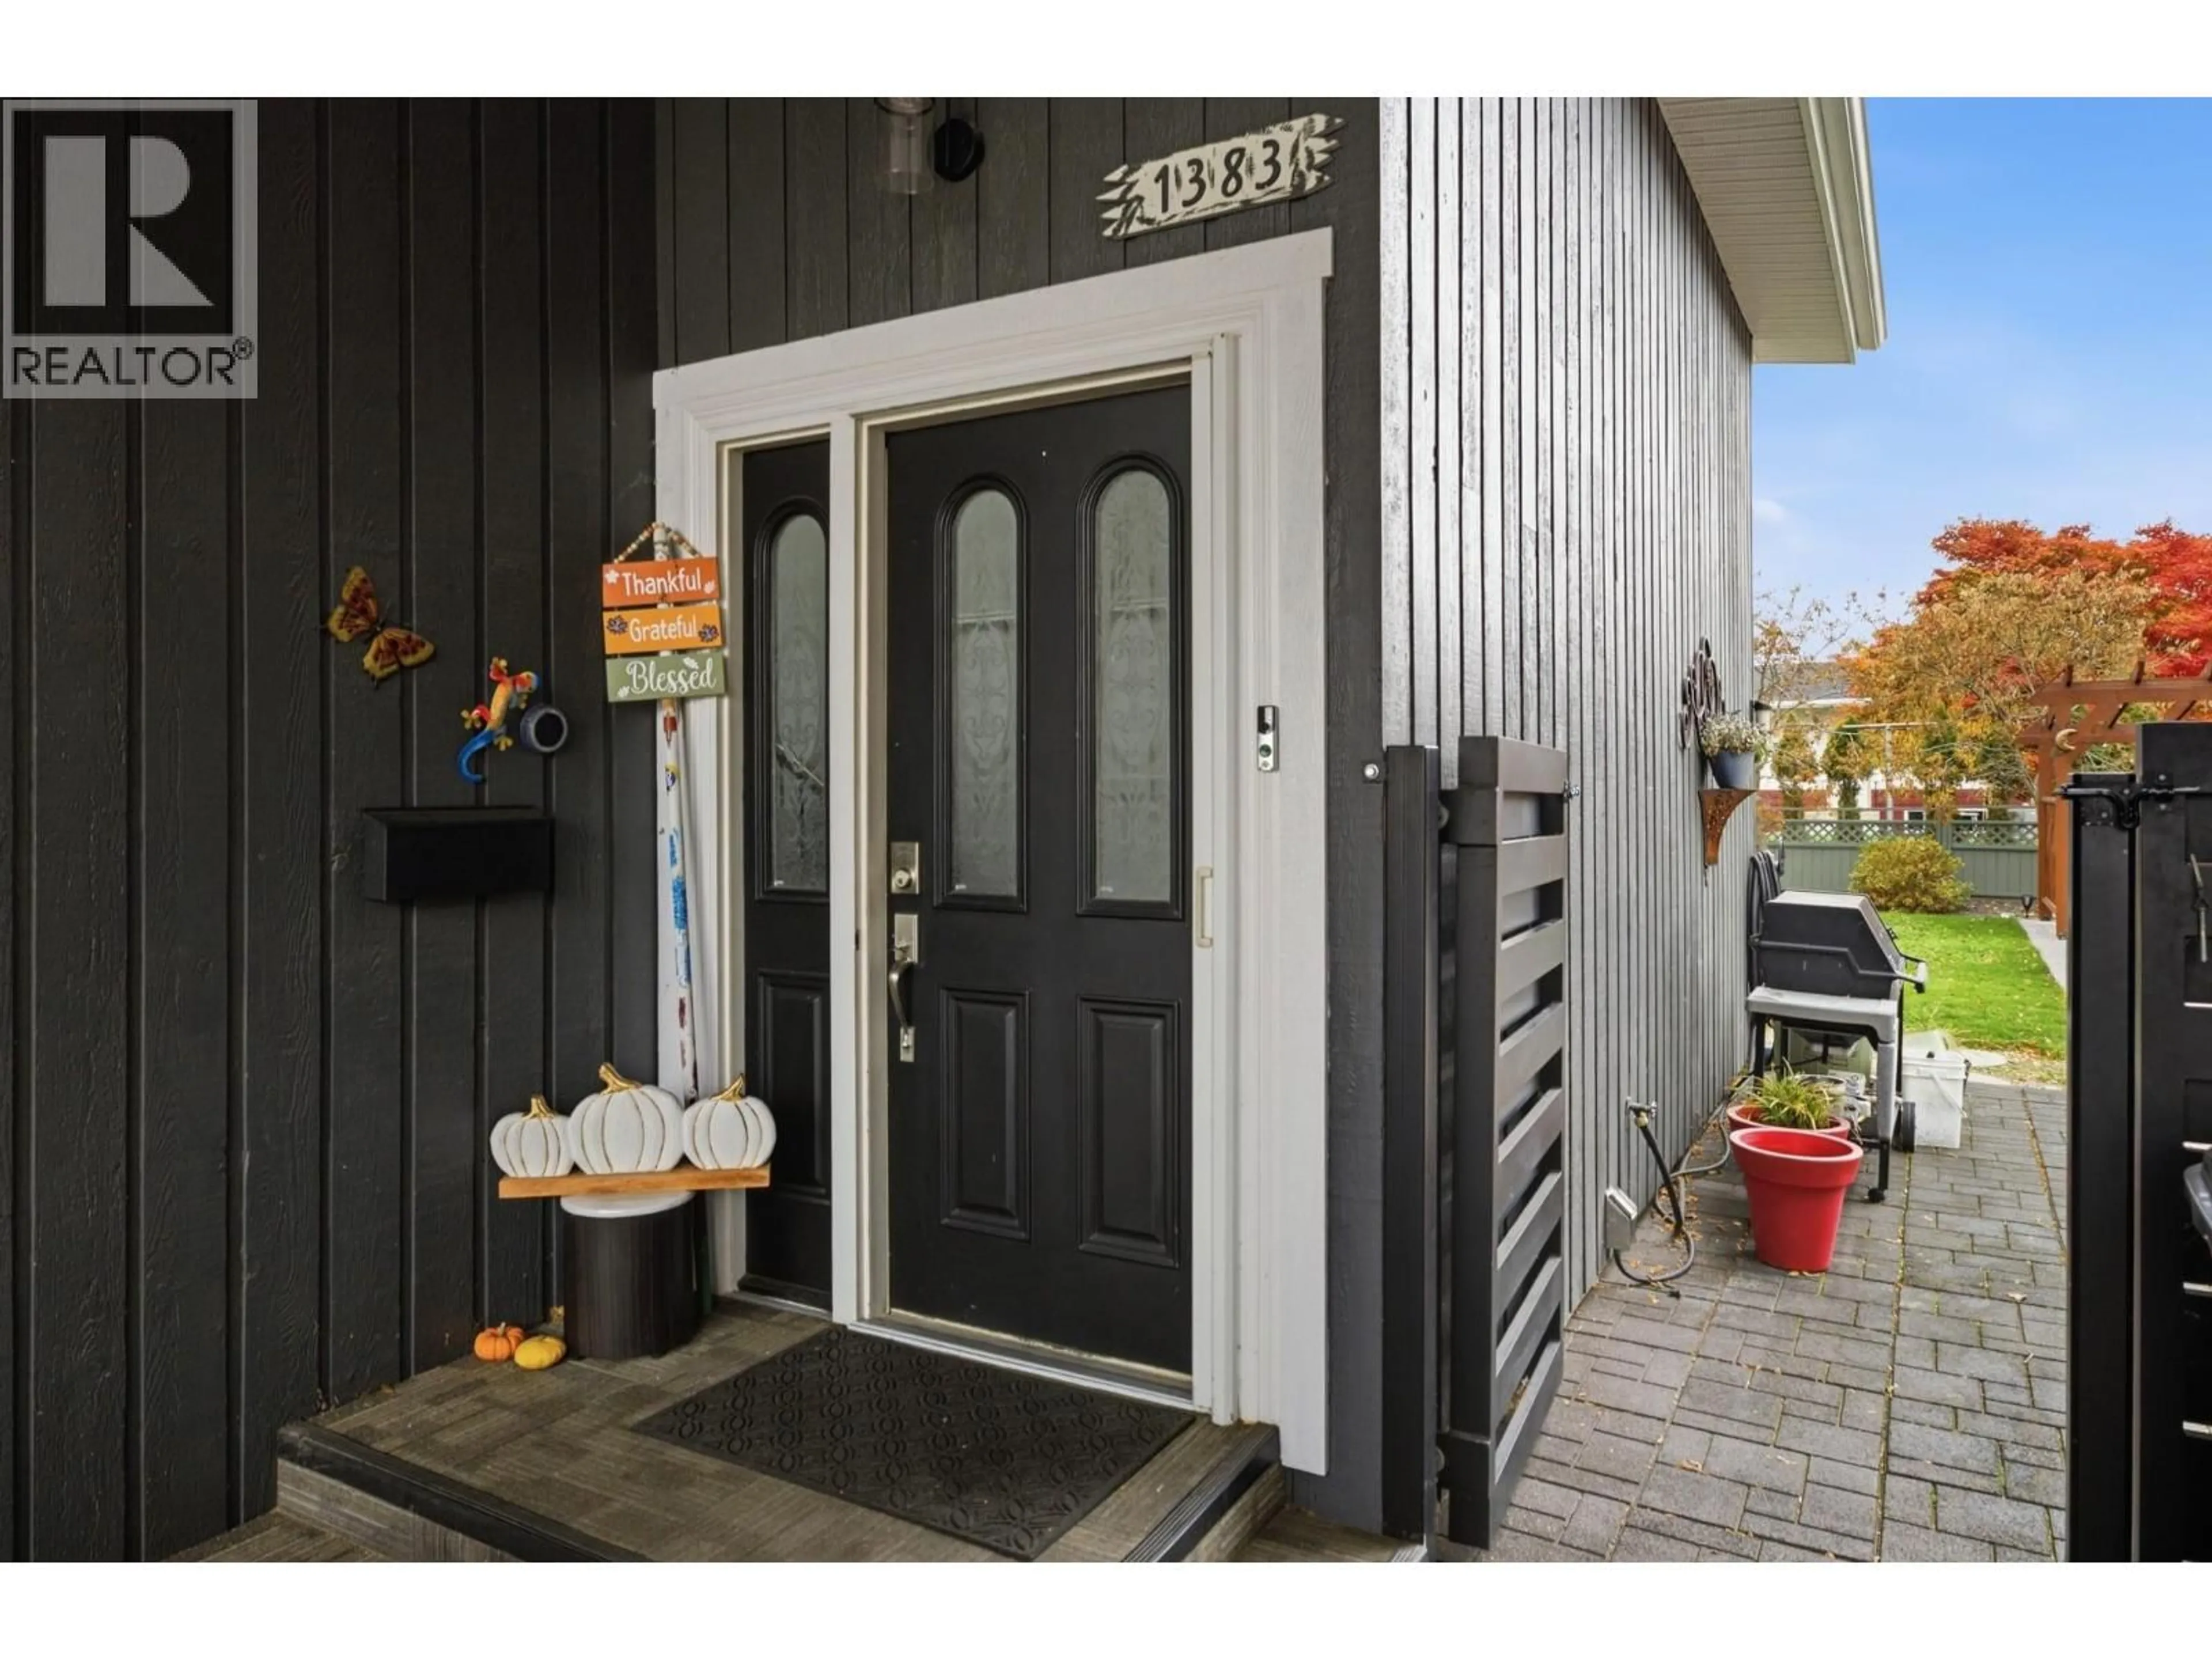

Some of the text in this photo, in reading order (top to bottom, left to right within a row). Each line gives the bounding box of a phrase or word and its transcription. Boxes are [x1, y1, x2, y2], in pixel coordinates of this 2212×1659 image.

[1154, 139, 1281, 213] 1383
[622, 567, 702, 596] Thankful
[628, 614, 698, 643] Grateful
[625, 657, 717, 695] Blessed
